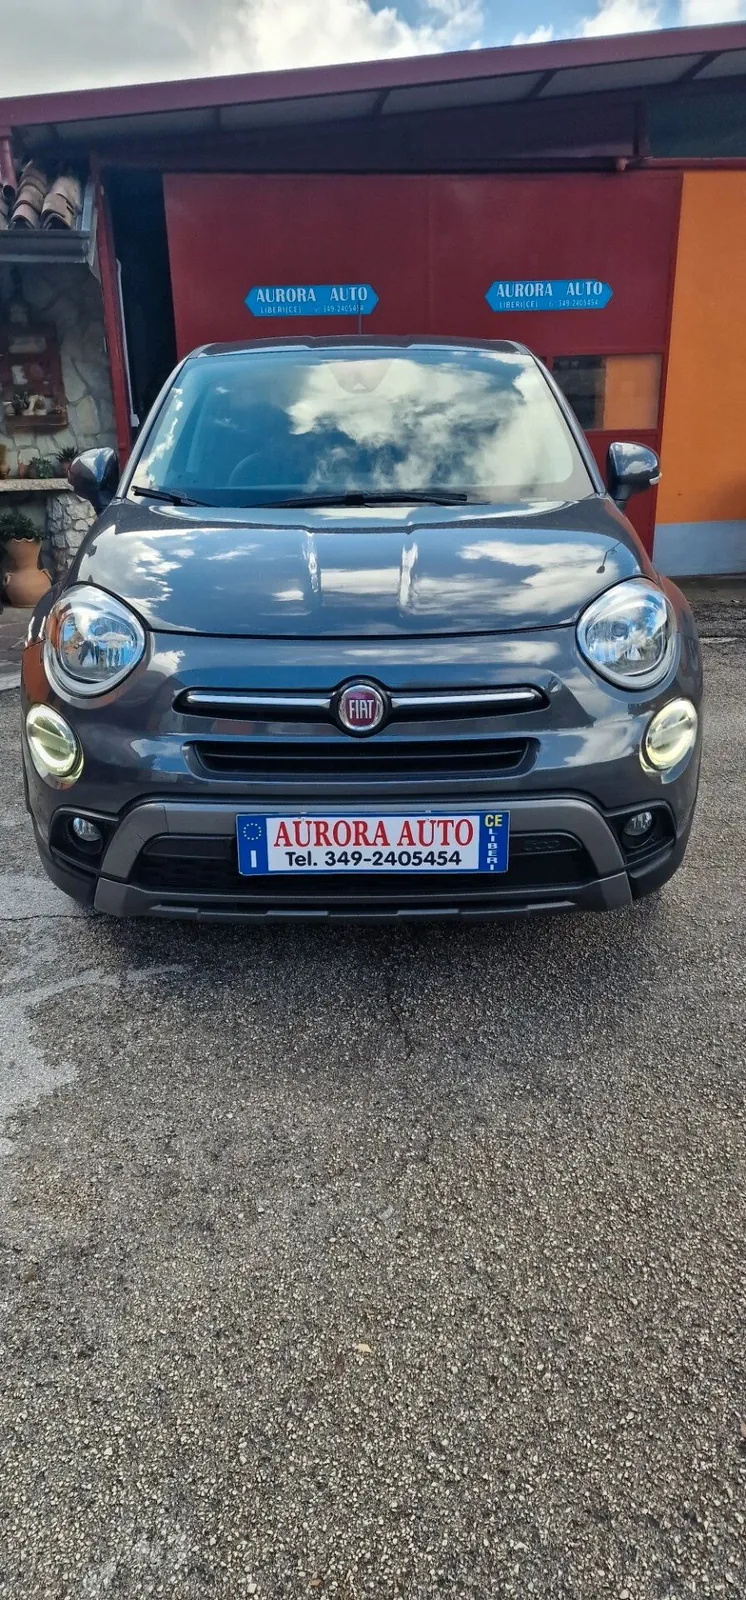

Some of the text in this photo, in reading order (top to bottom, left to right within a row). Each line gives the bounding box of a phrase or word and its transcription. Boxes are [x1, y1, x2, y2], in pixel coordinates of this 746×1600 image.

[256, 287, 367, 303] AURORA AUTO
[496, 281, 603, 298] AURORA AUTO
[349, 699, 374, 719] FIAT
[484, 814, 503, 827] CE
[273, 819, 474, 847] AURORA AUTO
[486, 828, 498, 871] LIBERI
[285, 850, 462, 867] Tel. 349-2405454
